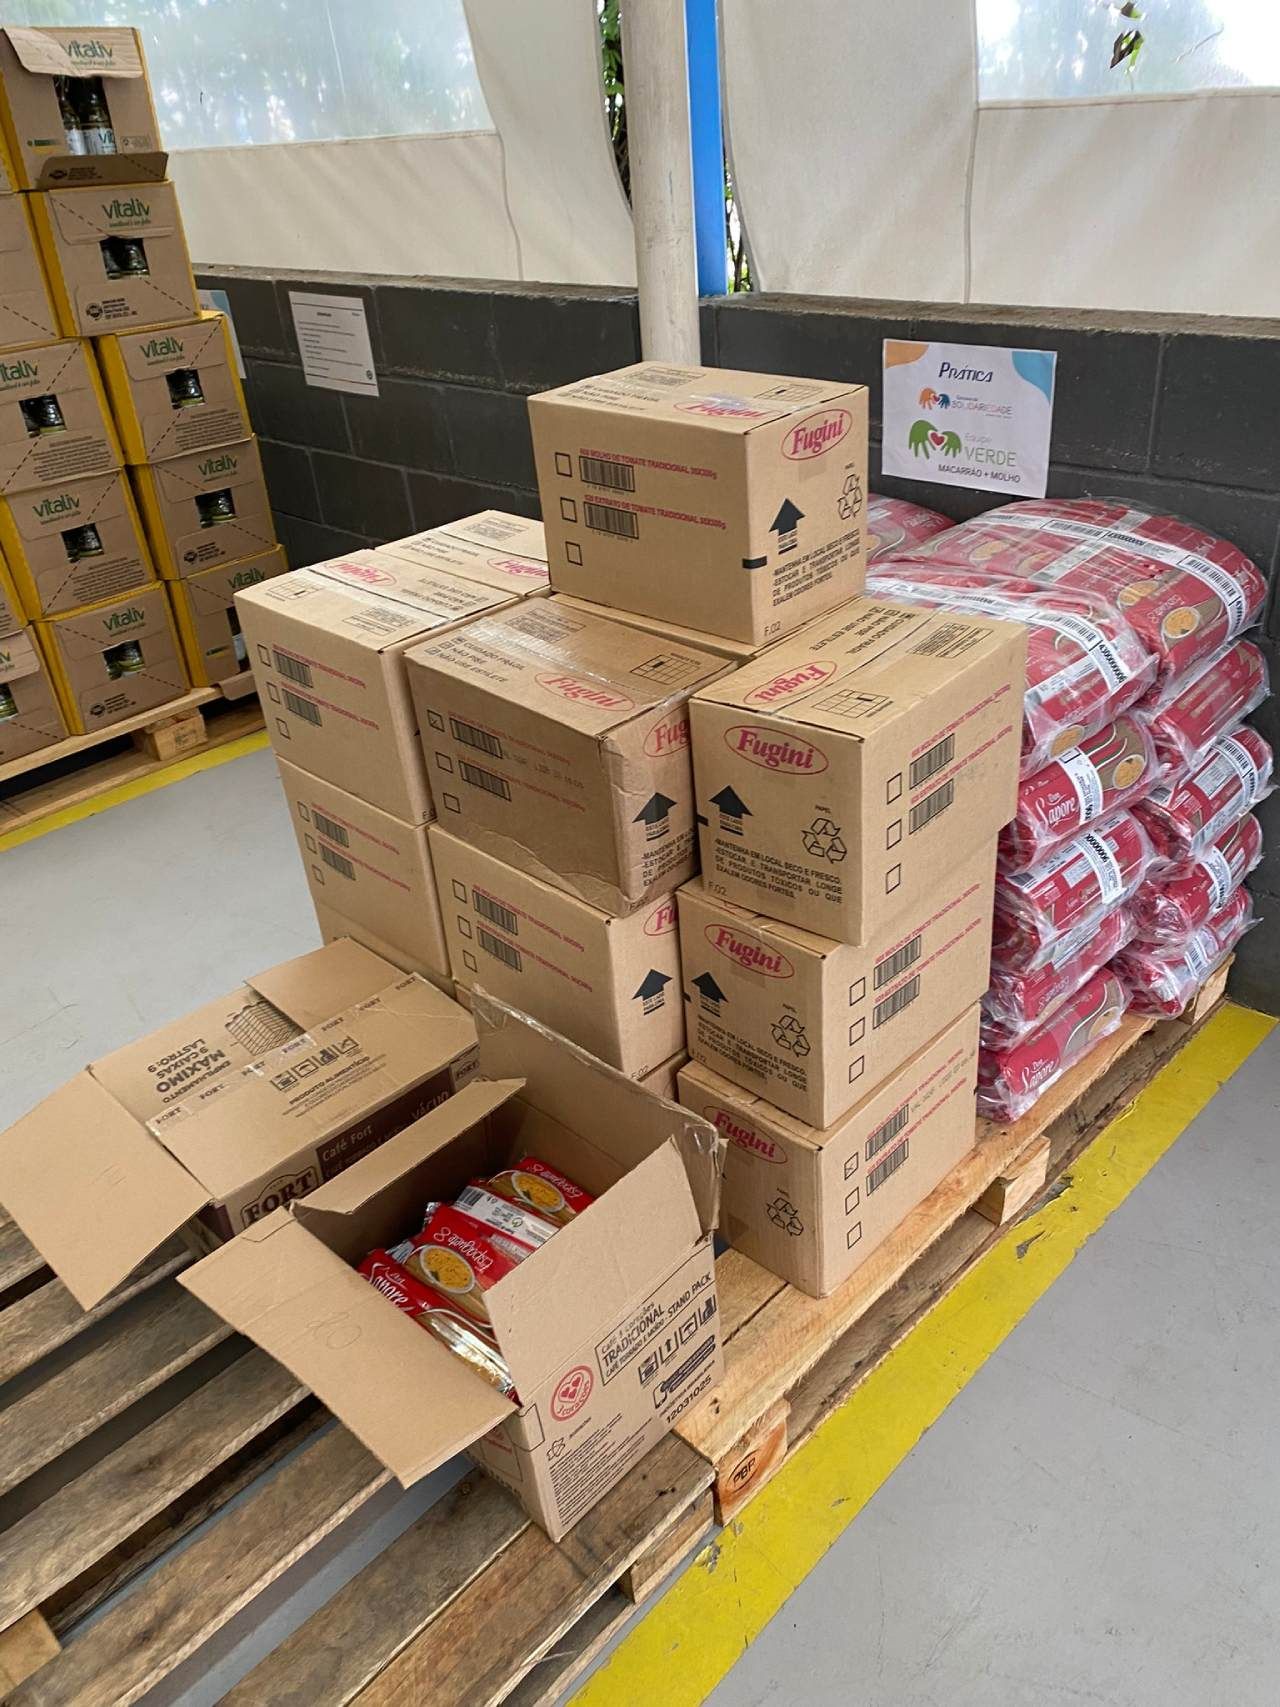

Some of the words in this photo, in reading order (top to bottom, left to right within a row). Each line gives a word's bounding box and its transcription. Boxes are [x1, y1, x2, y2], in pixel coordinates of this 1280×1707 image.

[790, 412, 844, 455] Fugini
[964, 447, 1016, 467] VERDE
[990, 472, 1020, 483] MOLHO
[543, 676, 626, 707] Fugini
[755, 664, 829, 701] Fugini
[738, 728, 816, 770] Fugini
[715, 931, 782, 975] Fugini
[156, 1051, 199, 1079] CAIXAS
[156, 1050, 226, 1092] MÁXIMO
[322, 1141, 347, 1162] Café
[351, 1125, 372, 1145] Fort
[712, 1110, 775, 1157] Fugini
[244, 1171, 313, 1224] FORT
[434, 1227, 451, 1242] 8
[667, 1290, 690, 1318] STAND
[692, 1272, 712, 1294] PACK
[602, 1304, 665, 1367] TRADICIONAL
[666, 1375, 712, 1424] 12031025
